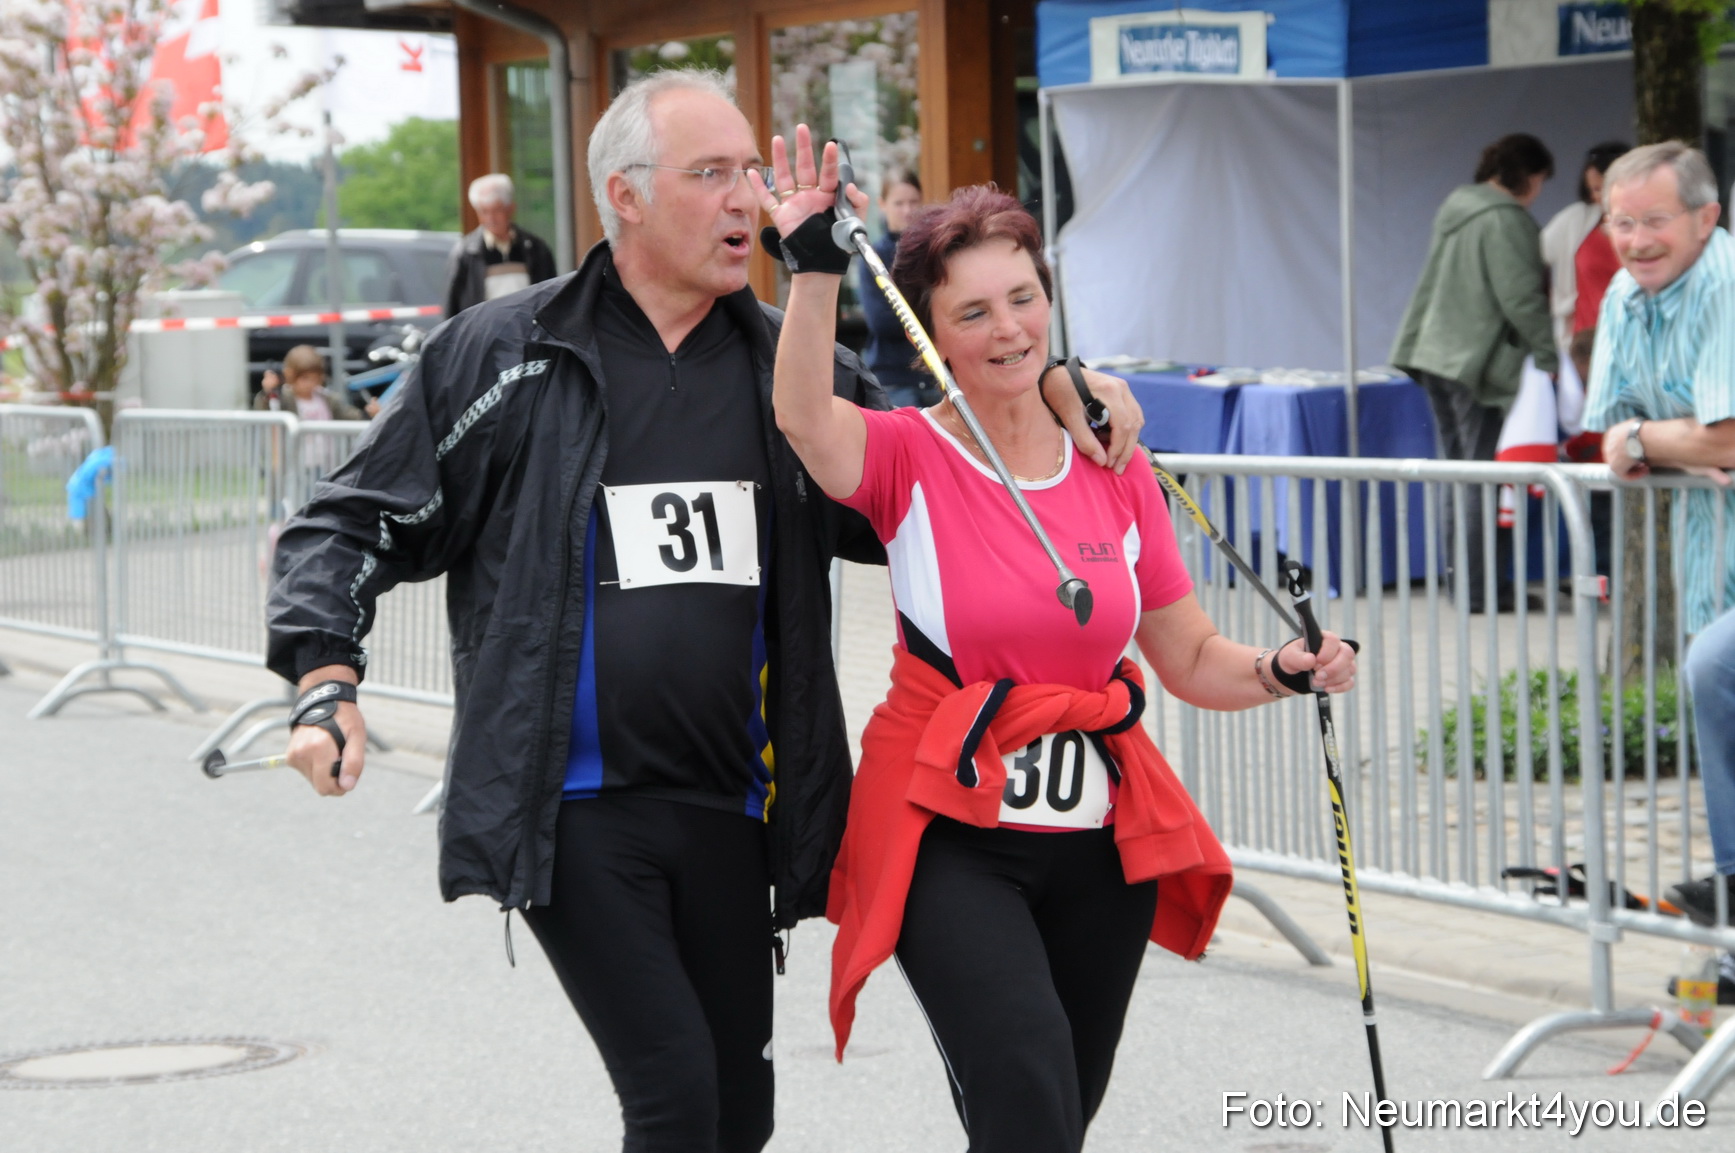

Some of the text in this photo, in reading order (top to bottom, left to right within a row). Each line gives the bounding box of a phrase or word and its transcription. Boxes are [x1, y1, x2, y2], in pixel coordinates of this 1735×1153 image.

[1571, 9, 1632, 44] Neu
[651, 491, 724, 573] 31
[1002, 729, 1085, 812] 30
